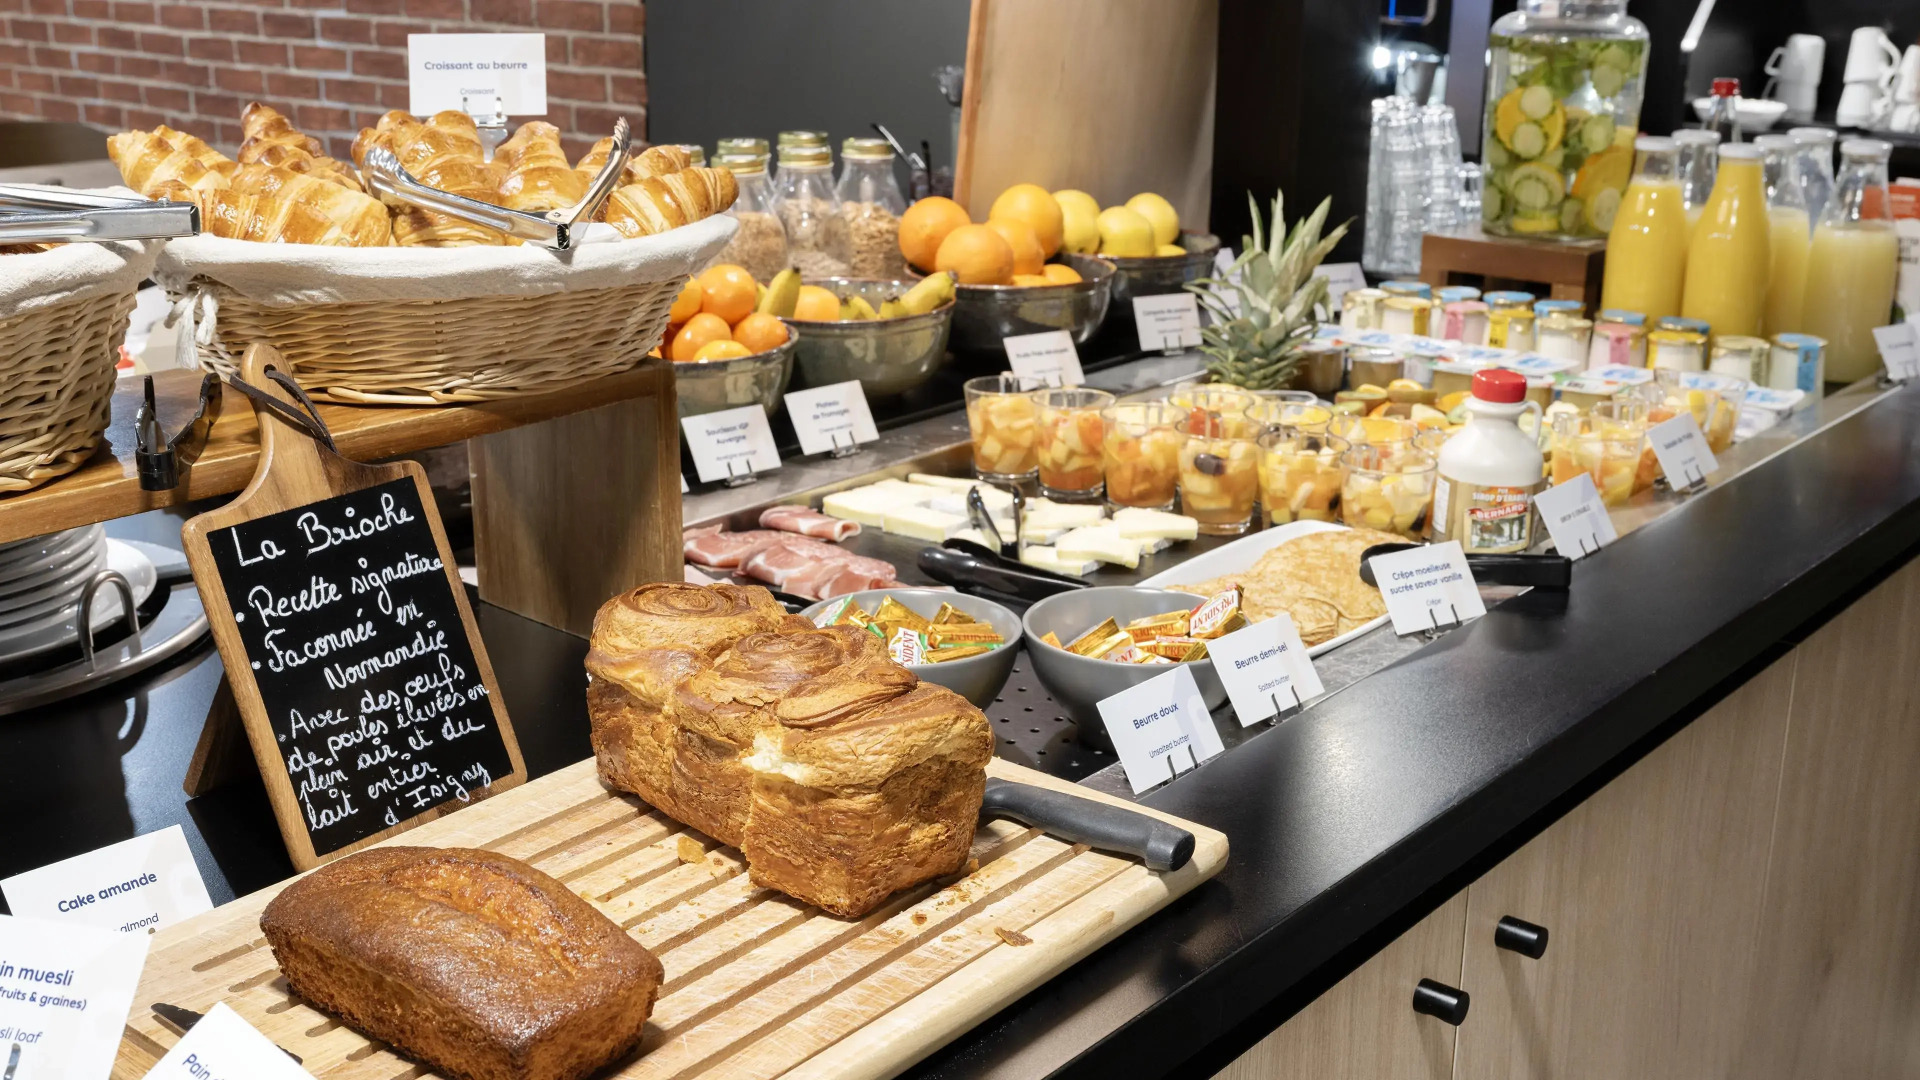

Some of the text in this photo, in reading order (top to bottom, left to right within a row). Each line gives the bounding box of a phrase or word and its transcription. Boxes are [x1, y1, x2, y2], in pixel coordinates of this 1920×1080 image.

[424, 60, 528, 70] Croissant au beurre
[1472, 491, 1496, 501] SIROP
[1477, 503, 1524, 519] BERNARD
[231, 493, 414, 567] La Brioche
[1389, 572, 1463, 595] sucrée saveur vanille
[1392, 562, 1451, 580] Crêpe moelleuse
[247, 551, 444, 628] Recette signature
[396, 598, 423, 627] en
[323, 619, 448, 690] Normandie
[902, 630, 915, 666] SIDENT
[1234, 641, 1289, 670] Beurre demi-sel
[1257, 673, 1290, 693] Salted butter
[290, 708, 349, 739] Avec
[360, 689, 401, 714] des
[1132, 701, 1179, 729] Beurre doux
[288, 746, 323, 775] de
[327, 714, 389, 762] poules
[467, 683, 490, 701] en
[299, 715, 486, 803] plein air et du
[1149, 733, 1190, 759] Unsalted butter
[306, 752, 438, 832] lait entier
[57, 871, 158, 913] Cake amande
[120, 912, 160, 933] almond
[17, 967, 74, 986] muesli
[28, 991, 38, 1003] &
[39, 995, 87, 1012] graines)
[14, 1028, 43, 1044] loaf
[181, 1052, 211, 1078] Pain
